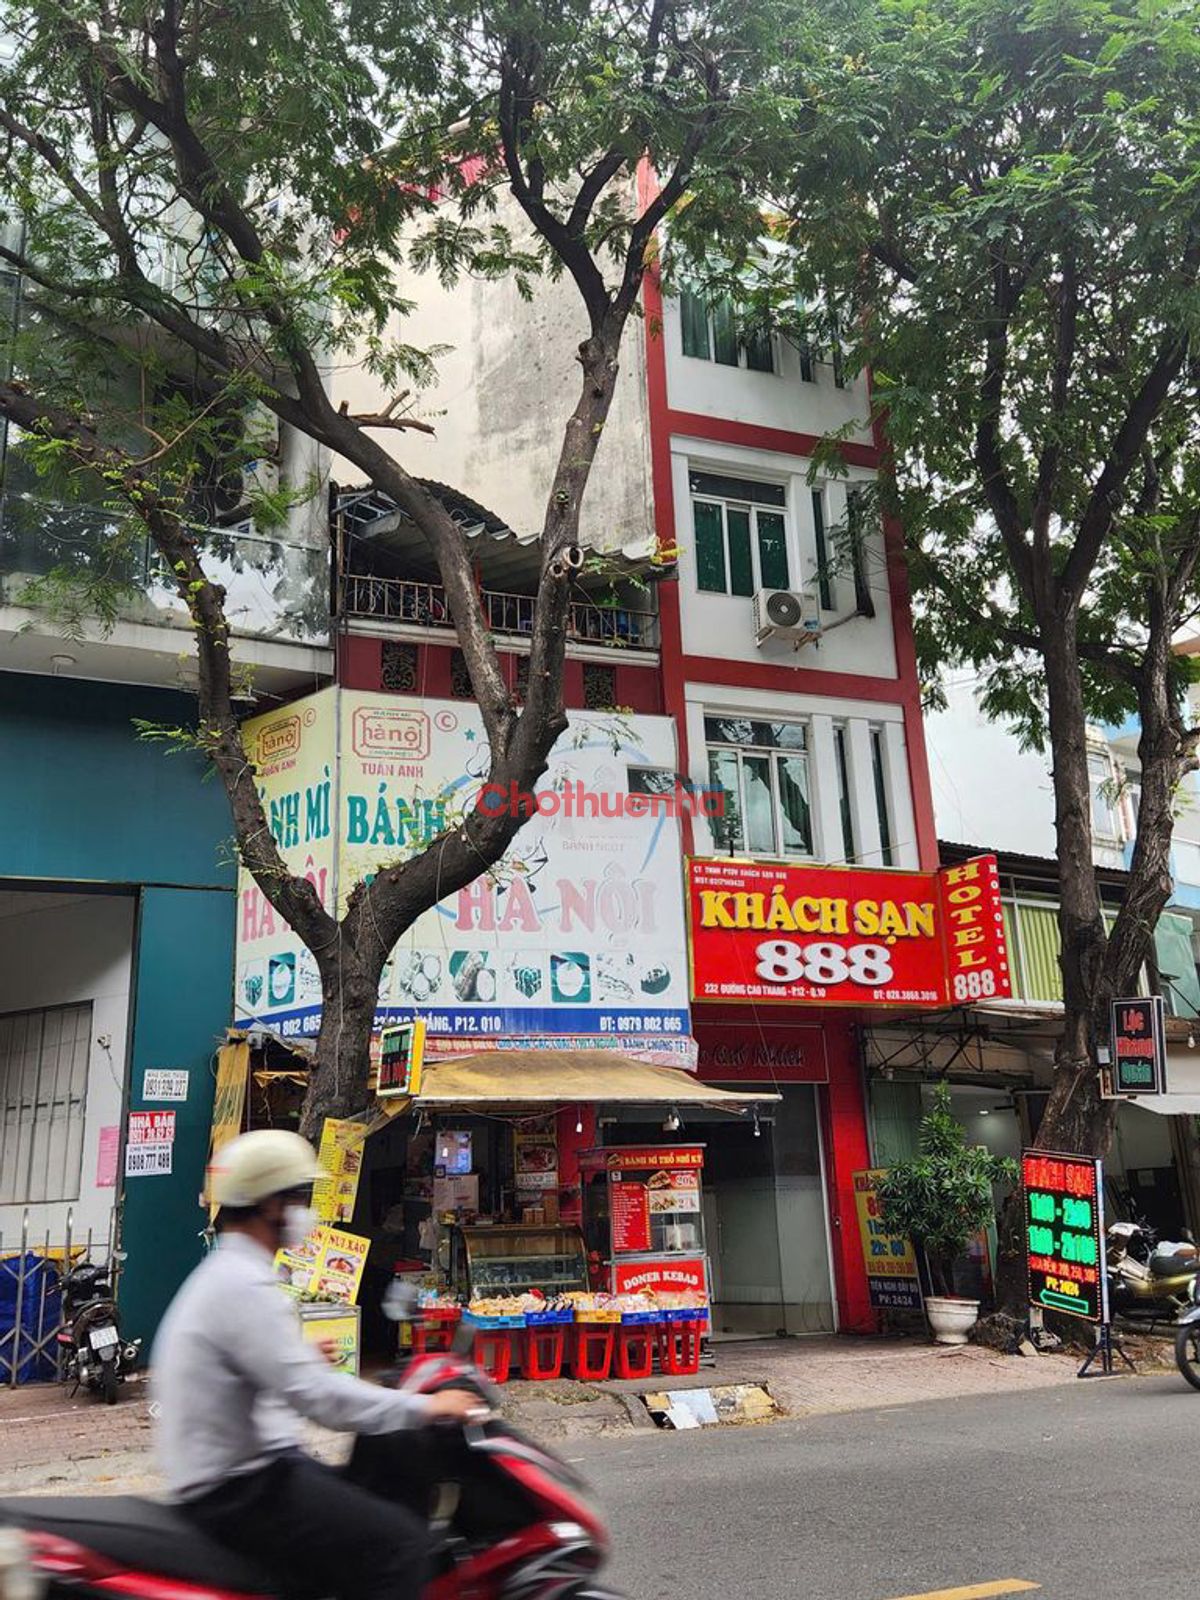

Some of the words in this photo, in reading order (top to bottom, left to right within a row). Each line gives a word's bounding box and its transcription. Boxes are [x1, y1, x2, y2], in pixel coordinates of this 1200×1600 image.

[700, 884, 849, 935] KHÁCH
[853, 900, 936, 945] SẠN
[945, 862, 987, 968] HOTEL
[756, 939, 894, 986] 888
[954, 968, 996, 1001] 888
[480, 1016, 502, 1032] Q10
[617, 1016, 641, 1032] 0979
[643, 1016, 661, 1031] 802
[663, 1016, 682, 1032] 665
[623, 1272, 661, 1290] DONER
[662, 1270, 698, 1285] KEBAB
